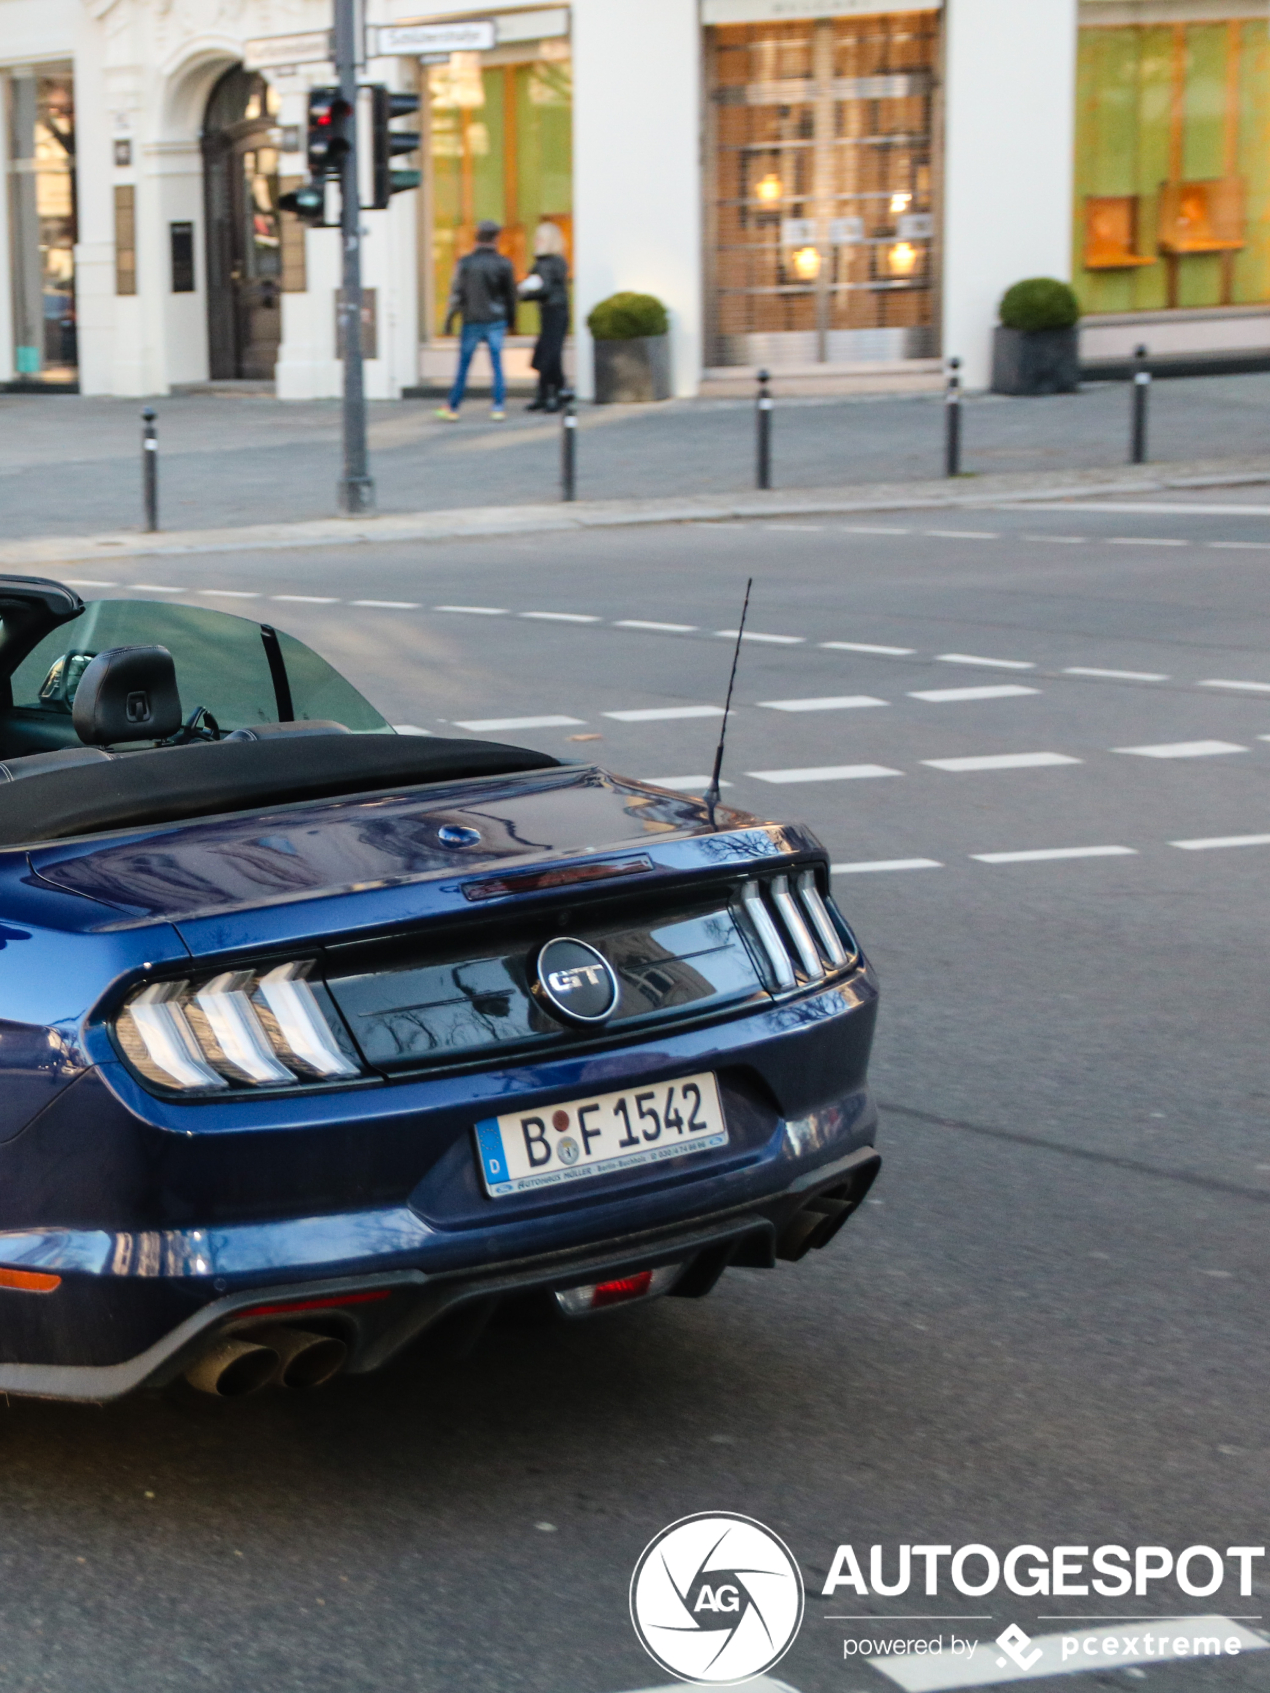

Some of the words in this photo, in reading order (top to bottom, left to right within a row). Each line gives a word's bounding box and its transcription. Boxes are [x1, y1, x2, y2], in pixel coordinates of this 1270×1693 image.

[548, 963, 604, 991] GT
[520, 1115, 552, 1168] B
[576, 1103, 602, 1155] F
[613, 1082, 707, 1149] 1542
[489, 1158, 501, 1174] D
